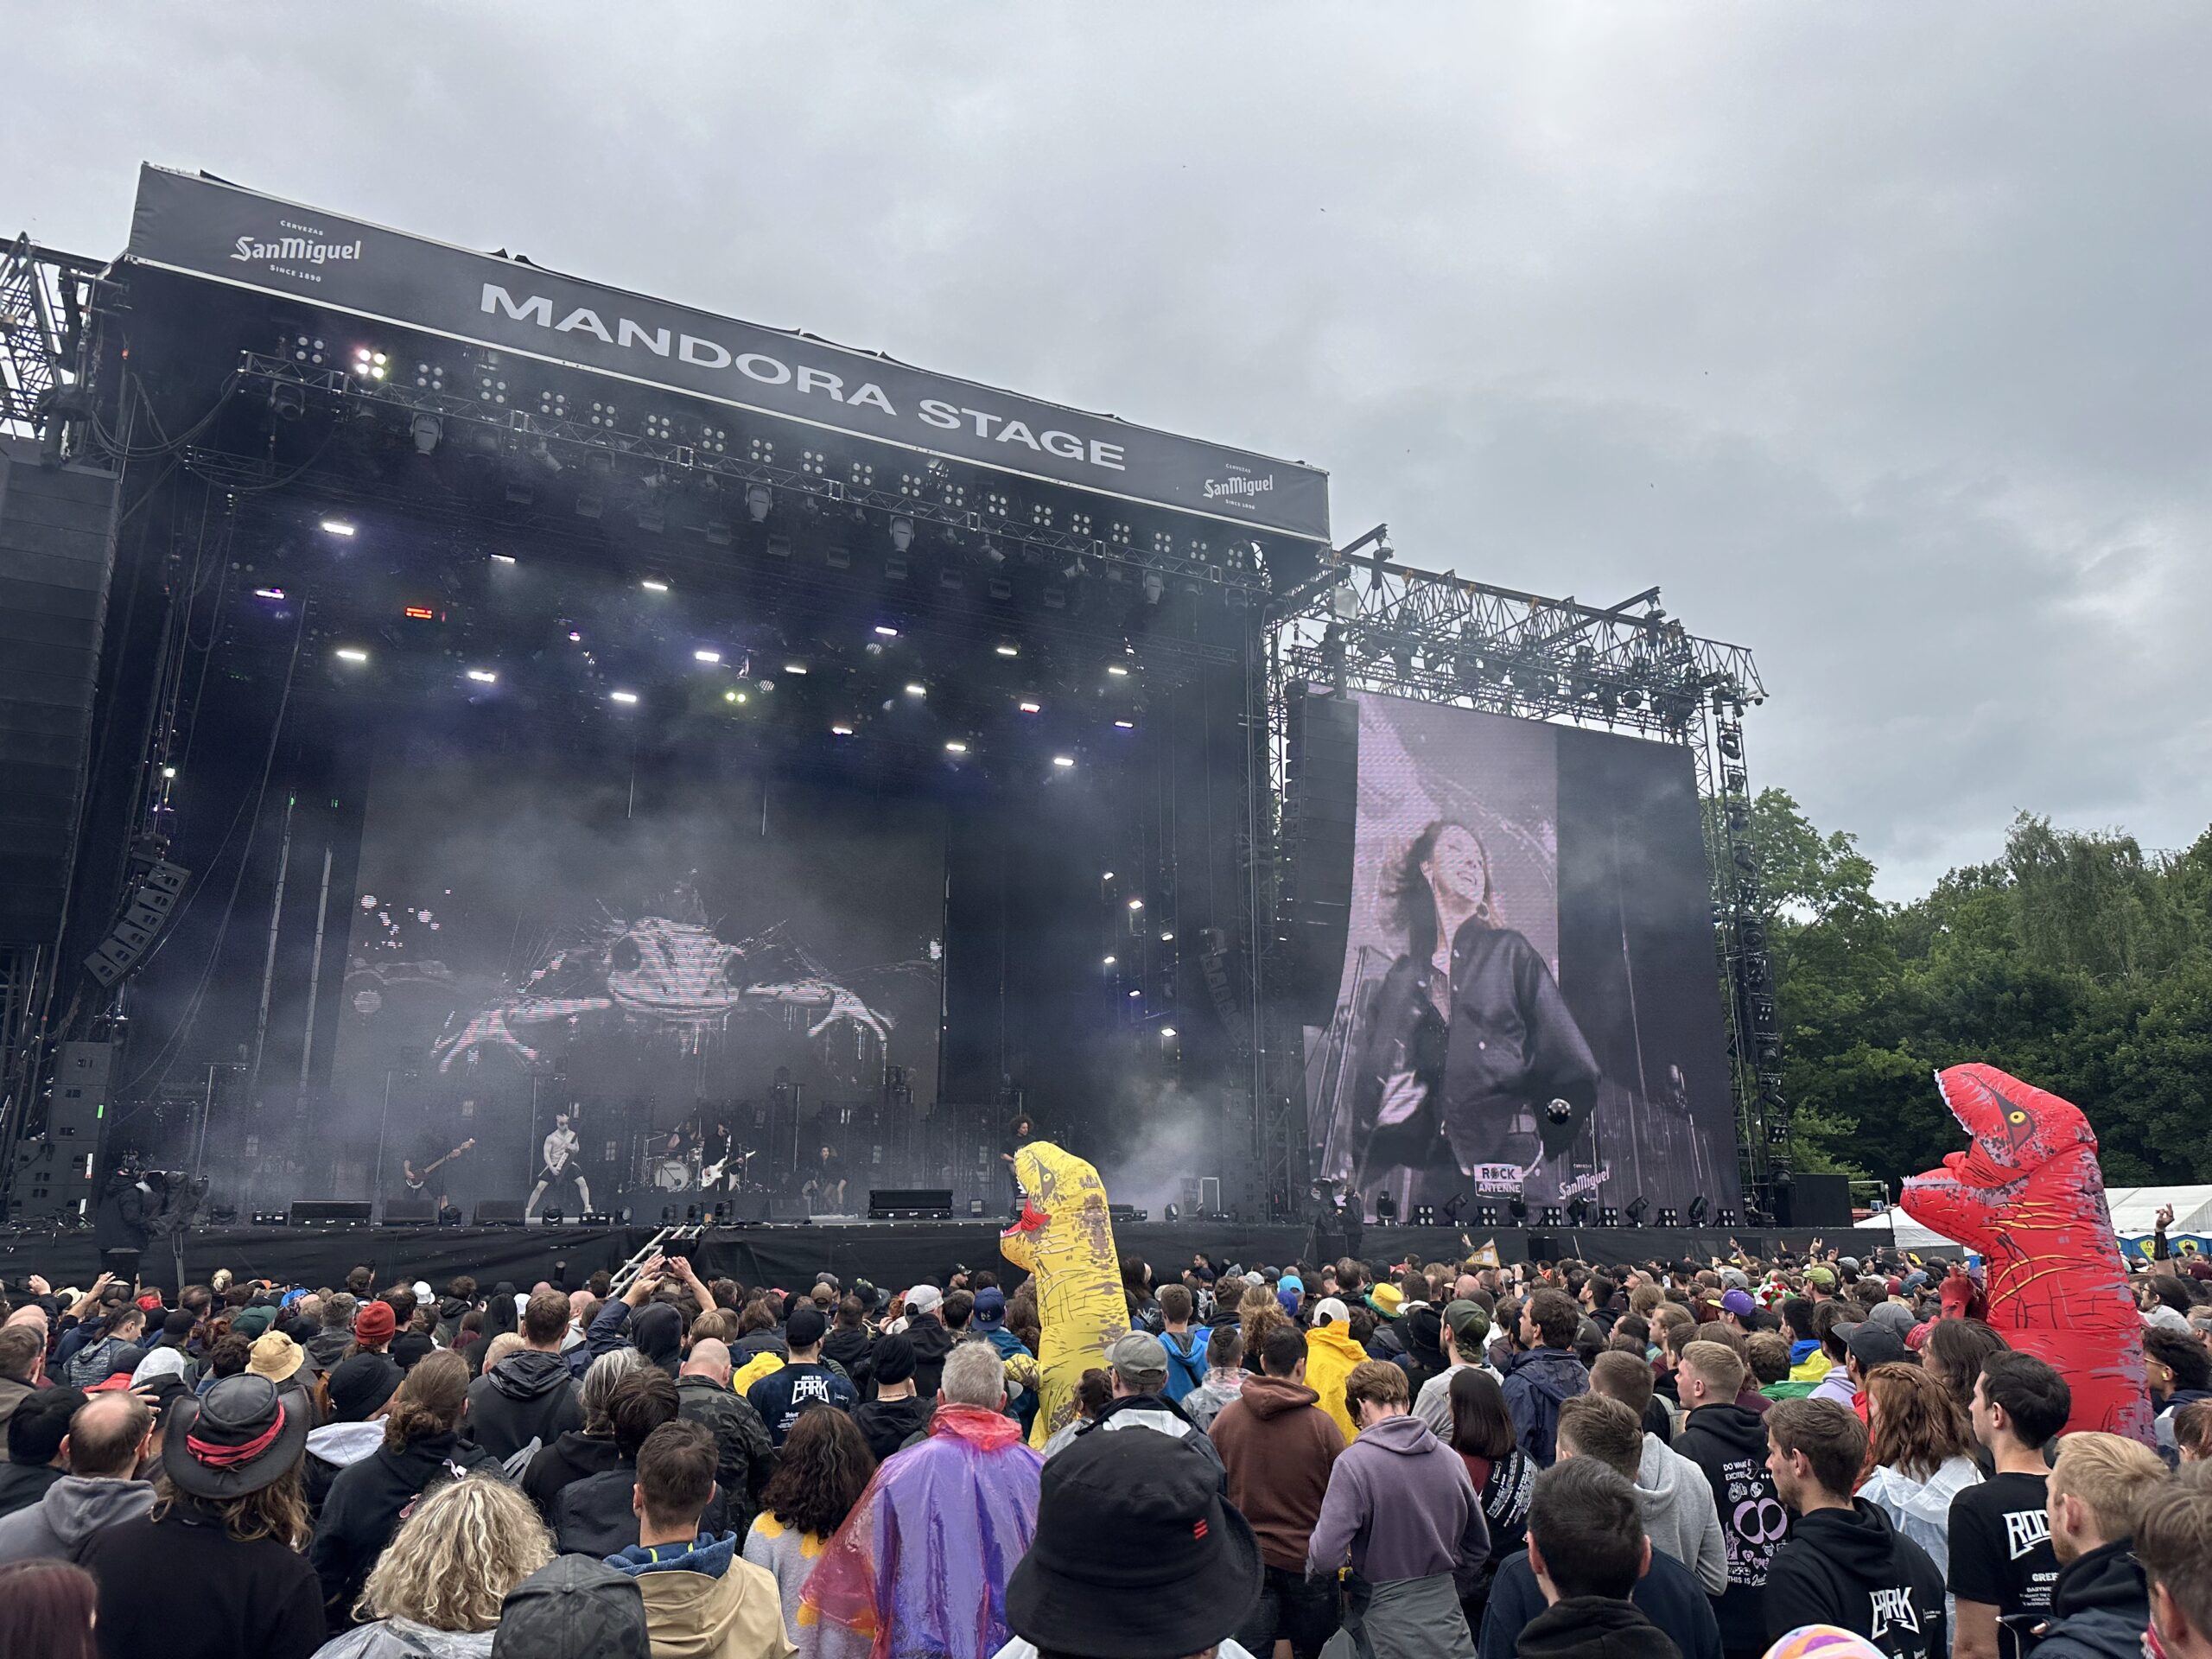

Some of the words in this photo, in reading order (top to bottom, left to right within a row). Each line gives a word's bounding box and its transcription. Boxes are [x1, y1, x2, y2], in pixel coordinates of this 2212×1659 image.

[280, 219, 324, 236] CERVEZAS
[270, 264, 296, 276] SINCE
[299, 271, 321, 283] 1890
[480, 283, 897, 416] MANDORA
[918, 399, 1125, 471] STAGE
[1482, 1167, 1516, 1180] ROCK
[1478, 1182, 1521, 1192] ANTENNE
[791, 1380, 830, 1404] PARK
[1723, 1462, 1733, 1471] DO
[2002, 1510, 2052, 1560] ROC
[1727, 1575, 1742, 1584] THIS
[1868, 1586, 1920, 1640] PARK
